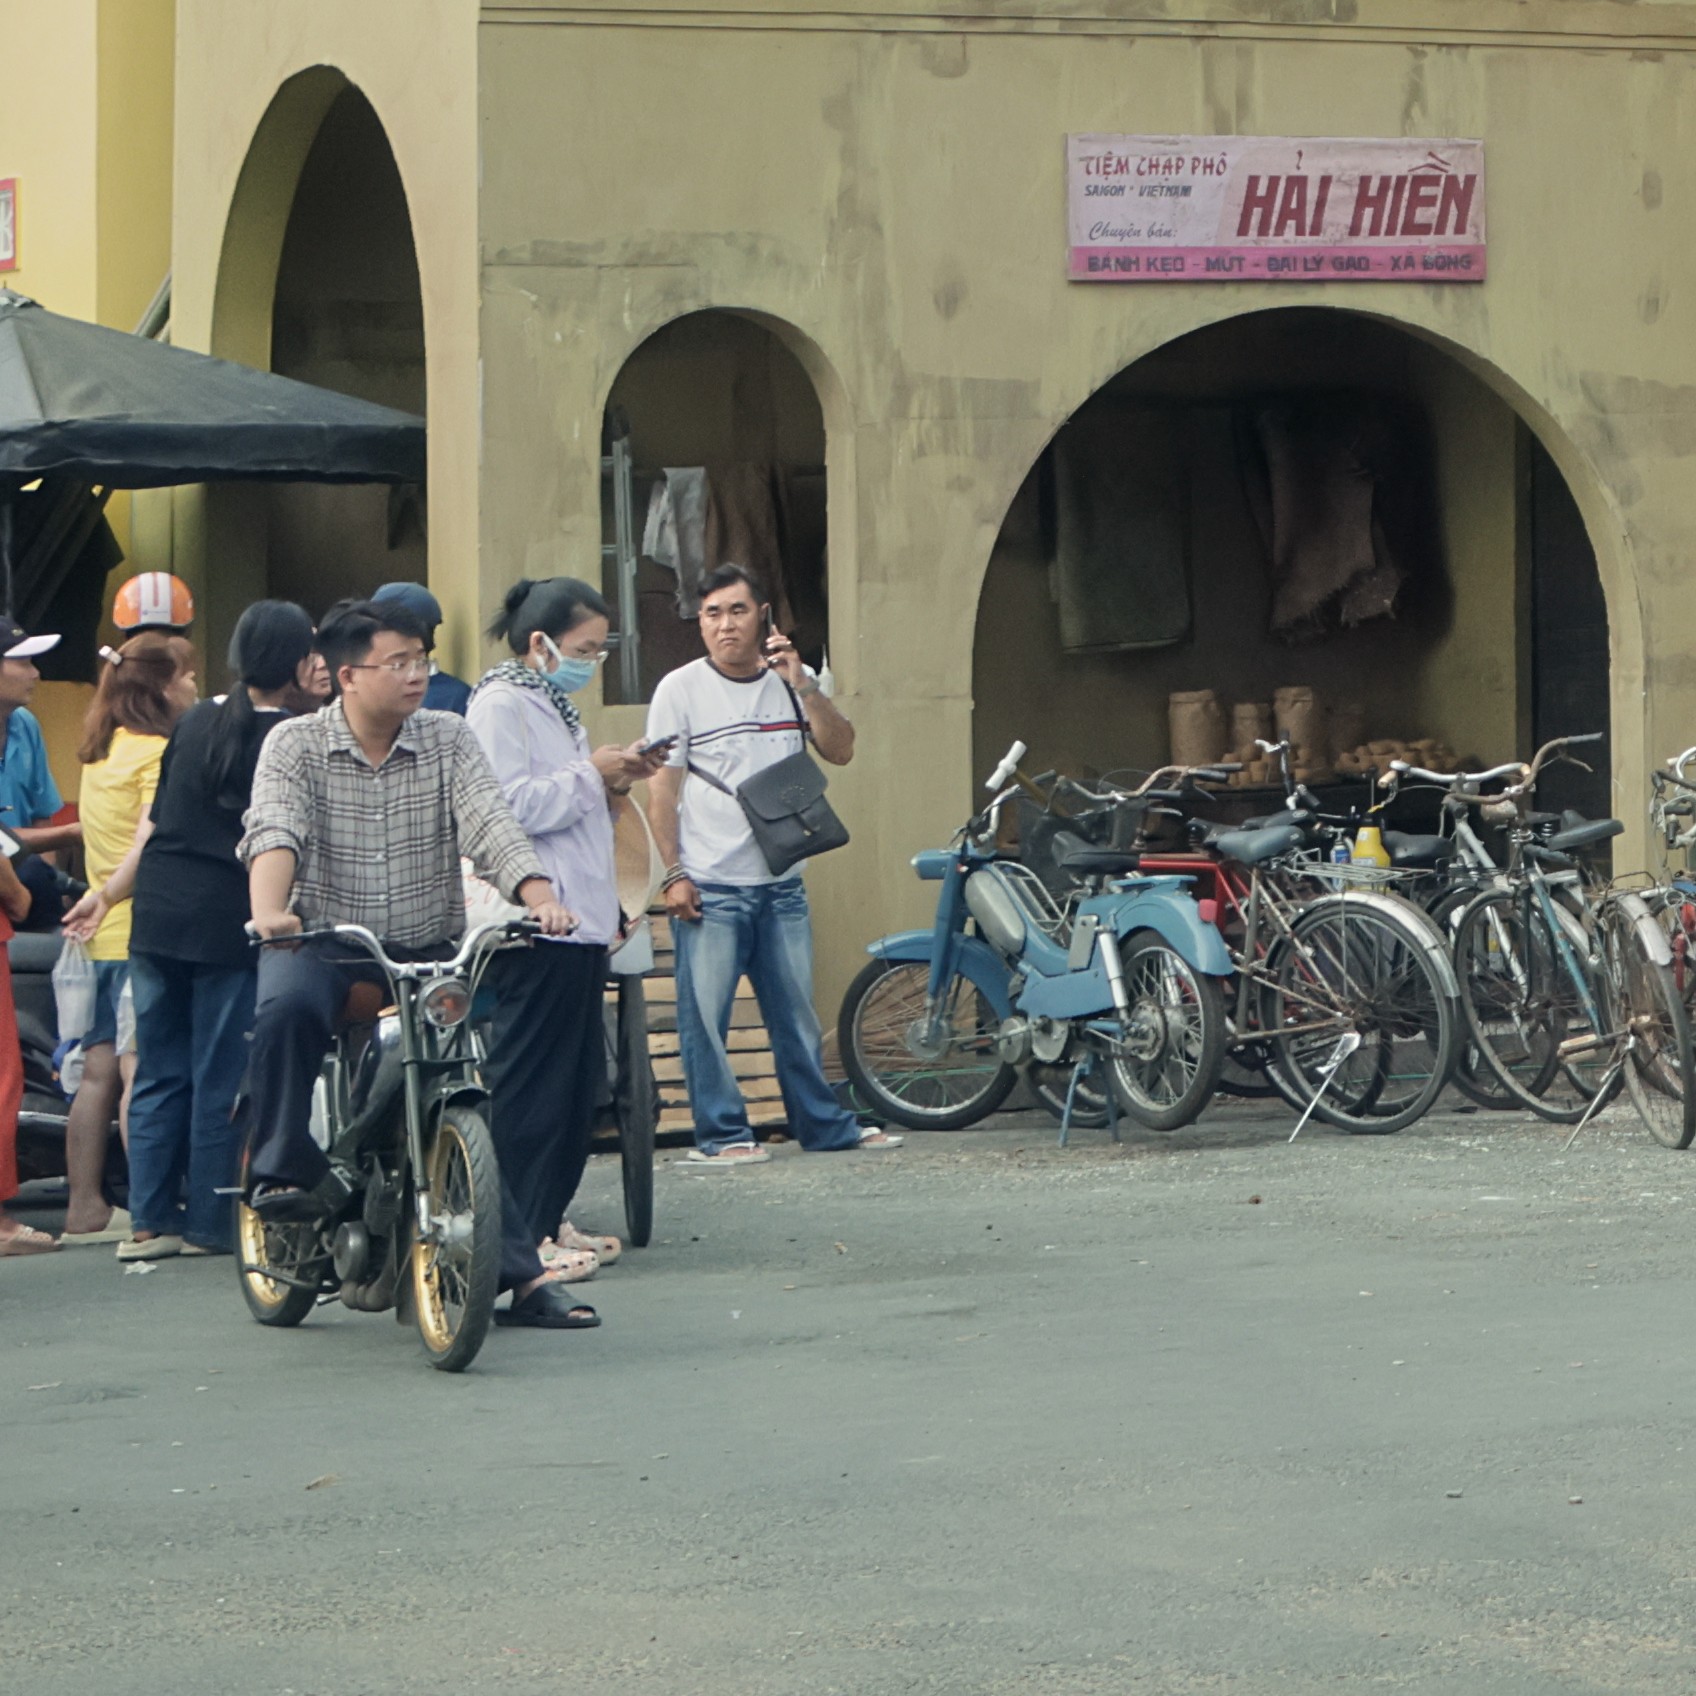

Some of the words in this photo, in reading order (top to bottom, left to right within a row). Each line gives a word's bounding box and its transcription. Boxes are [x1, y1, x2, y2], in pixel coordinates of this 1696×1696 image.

[1085, 151, 1130, 180] TIỆM
[1136, 156, 1185, 181] CHẠP
[1084, 184, 1126, 197] SAIGON
[1138, 185, 1193, 197] VIETNAM
[1236, 150, 1333, 237] HẢI
[1348, 151, 1478, 236] HIỀN
[1089, 221, 1142, 242] Chuyên
